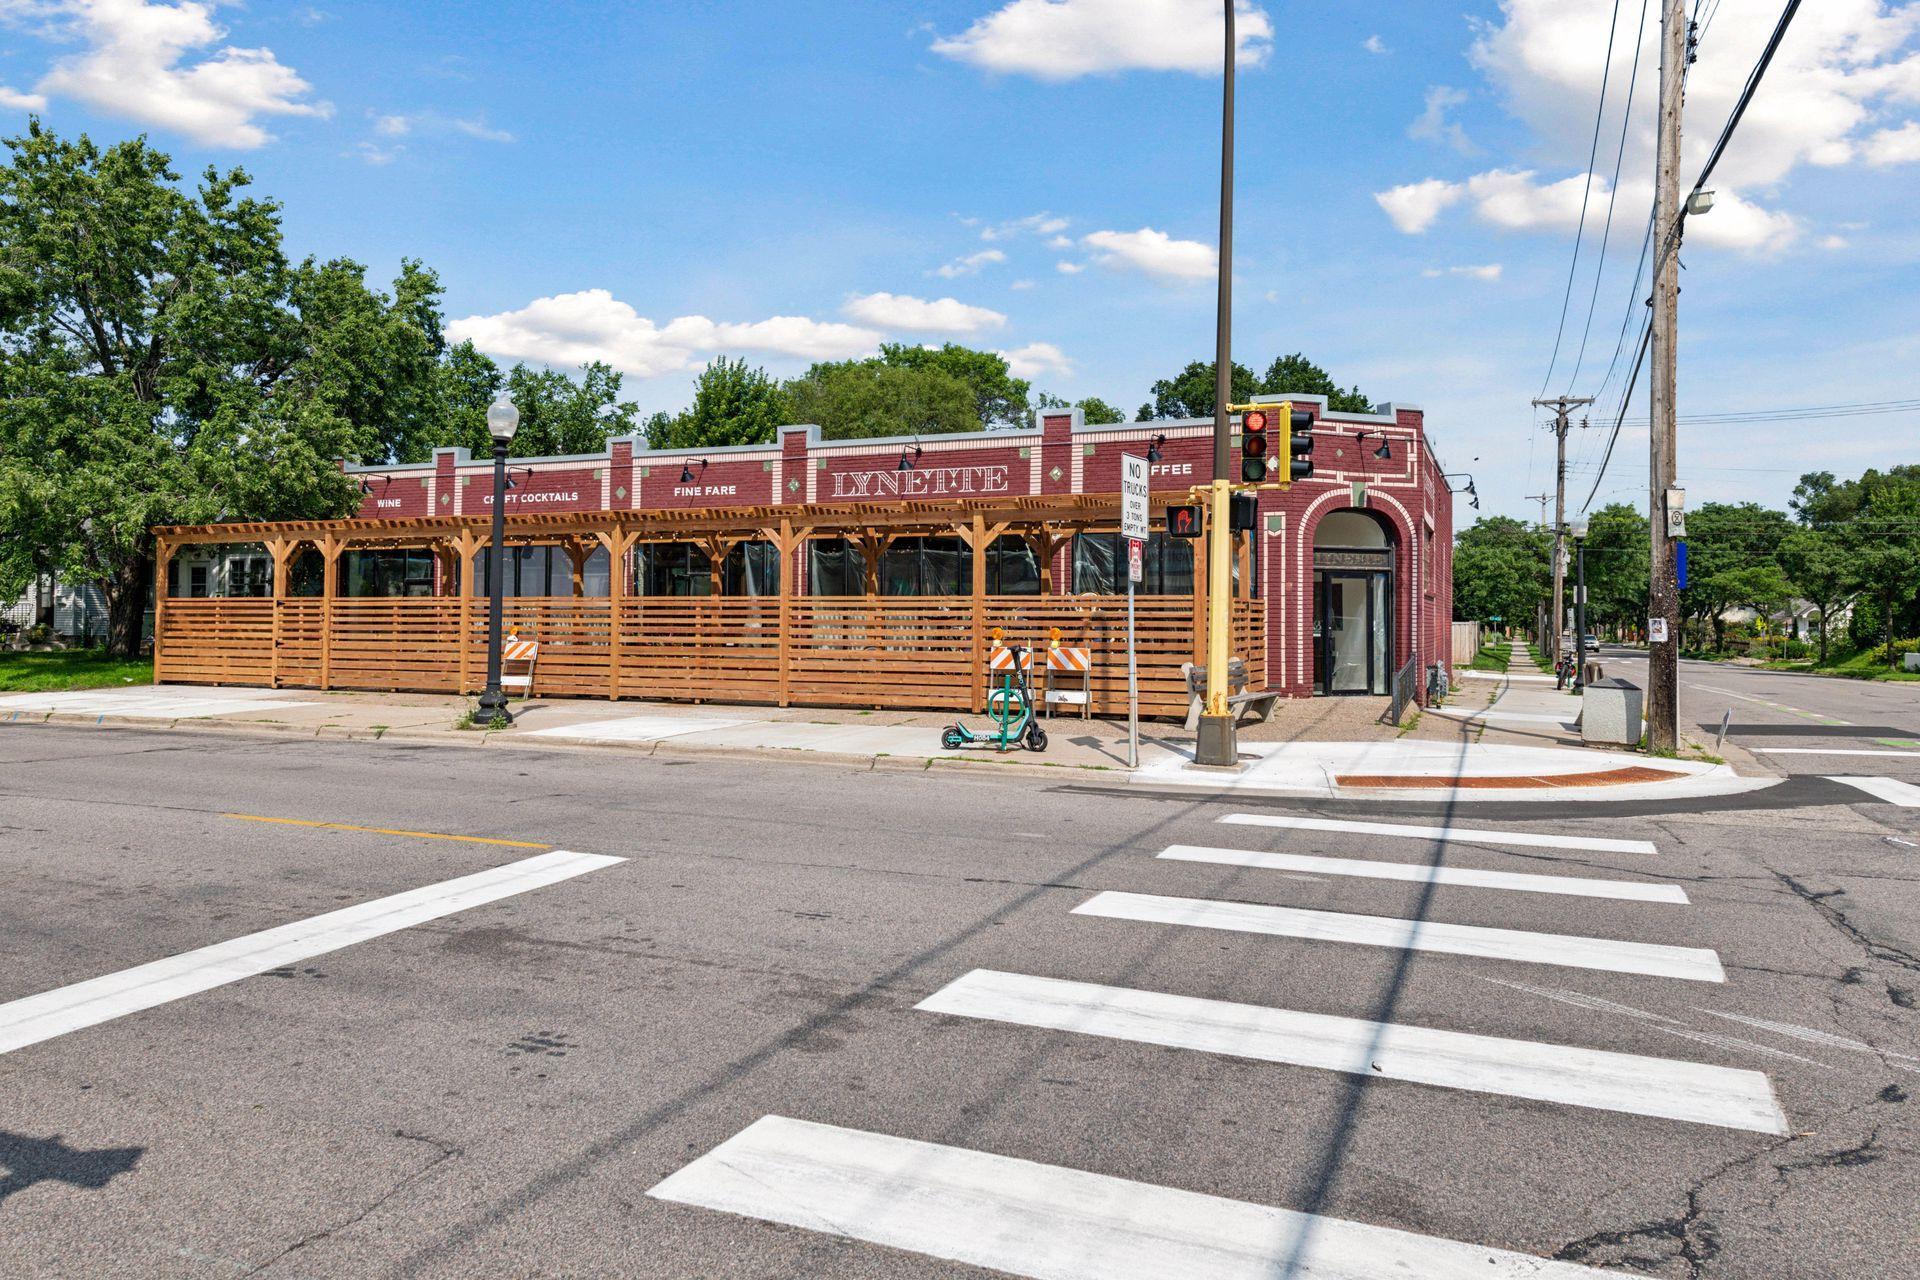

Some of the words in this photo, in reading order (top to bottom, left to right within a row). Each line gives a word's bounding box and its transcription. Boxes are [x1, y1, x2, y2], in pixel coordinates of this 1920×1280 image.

[1129, 462, 1141, 479] NO
[1151, 463, 1192, 476] FFEE
[832, 466, 1008, 497] LYNETTE
[674, 486, 701, 497] FINE
[705, 485, 736, 496] FARE
[1123, 480, 1147, 498] TRUCKS
[520, 492, 578, 503] COCKTAILS
[377, 499, 401, 508] WINE
[1129, 500, 1141, 511] OVER
[1131, 512, 1143, 522] TONS
[1123, 522, 1139, 533] EMPTY
